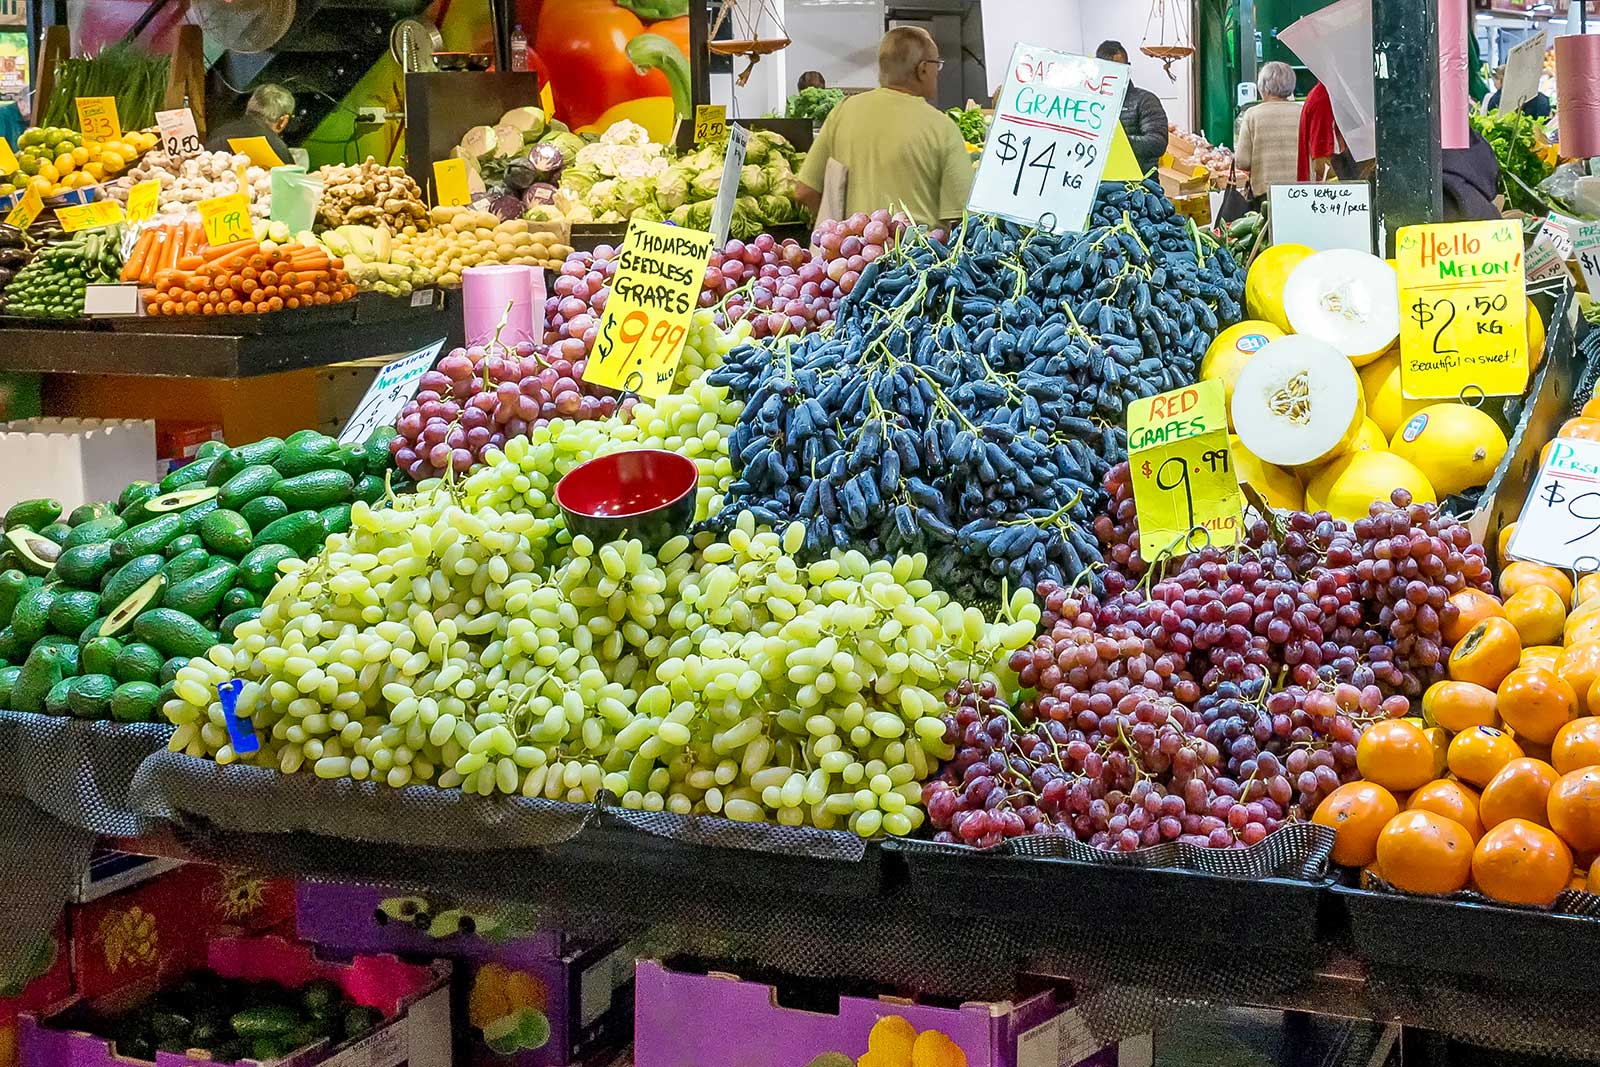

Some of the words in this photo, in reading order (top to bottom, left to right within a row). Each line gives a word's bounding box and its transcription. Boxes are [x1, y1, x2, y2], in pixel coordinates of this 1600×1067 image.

[1015, 87, 1105, 130] GRAPES
[1421, 231, 1481, 268] Hello
[620, 250, 693, 286] SEEDLESS
[615, 276, 690, 315] GRAPES
[1476, 319, 1503, 335] KG
[1410, 355, 1460, 373] Beautiful
[1149, 389, 1199, 422] RED
[1129, 416, 1206, 450] GRAPES
